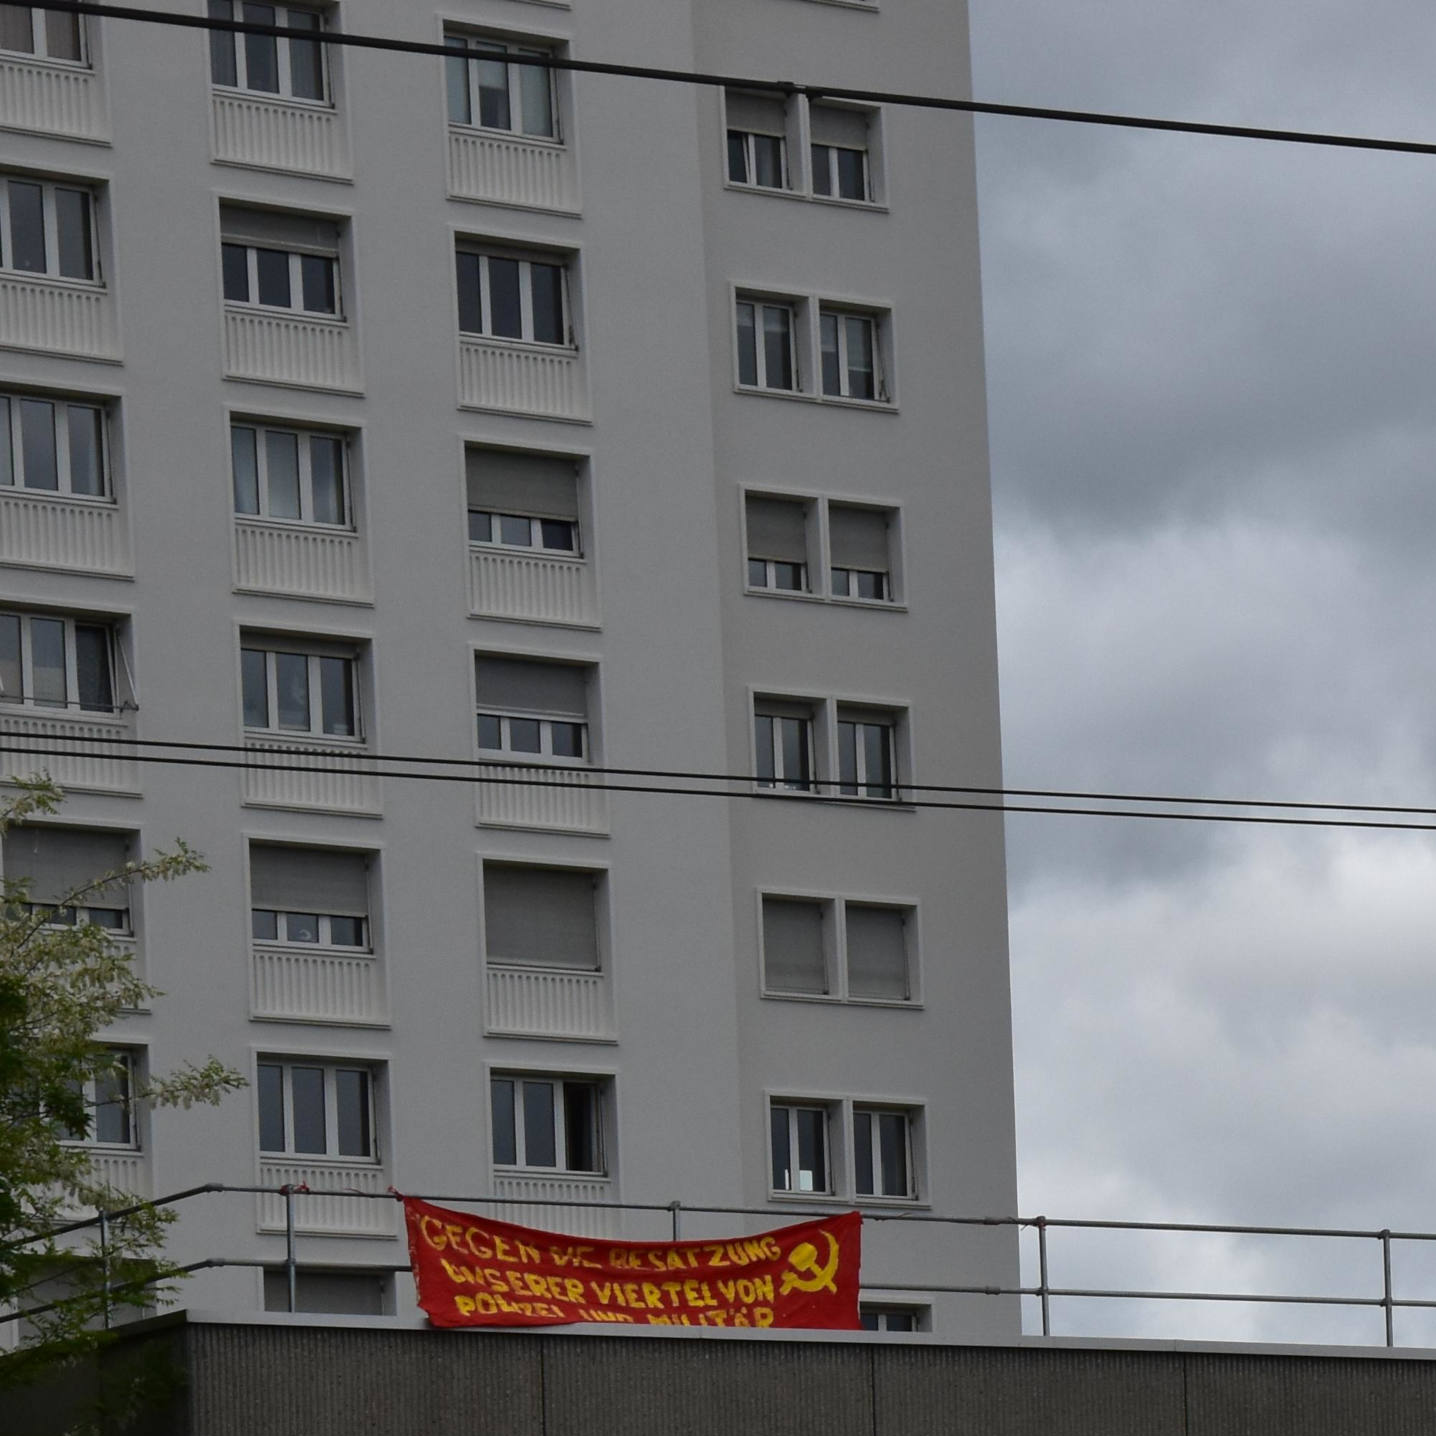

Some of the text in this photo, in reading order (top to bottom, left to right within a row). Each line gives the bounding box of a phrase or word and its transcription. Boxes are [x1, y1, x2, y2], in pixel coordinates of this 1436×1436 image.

[419, 1215, 541, 1264] GEGEN
[609, 1236, 782, 1272] BESATZUNG
[440, 1257, 775, 1309] UNSERER VIERTEL VON
[454, 1291, 566, 1319] POLIZEI
